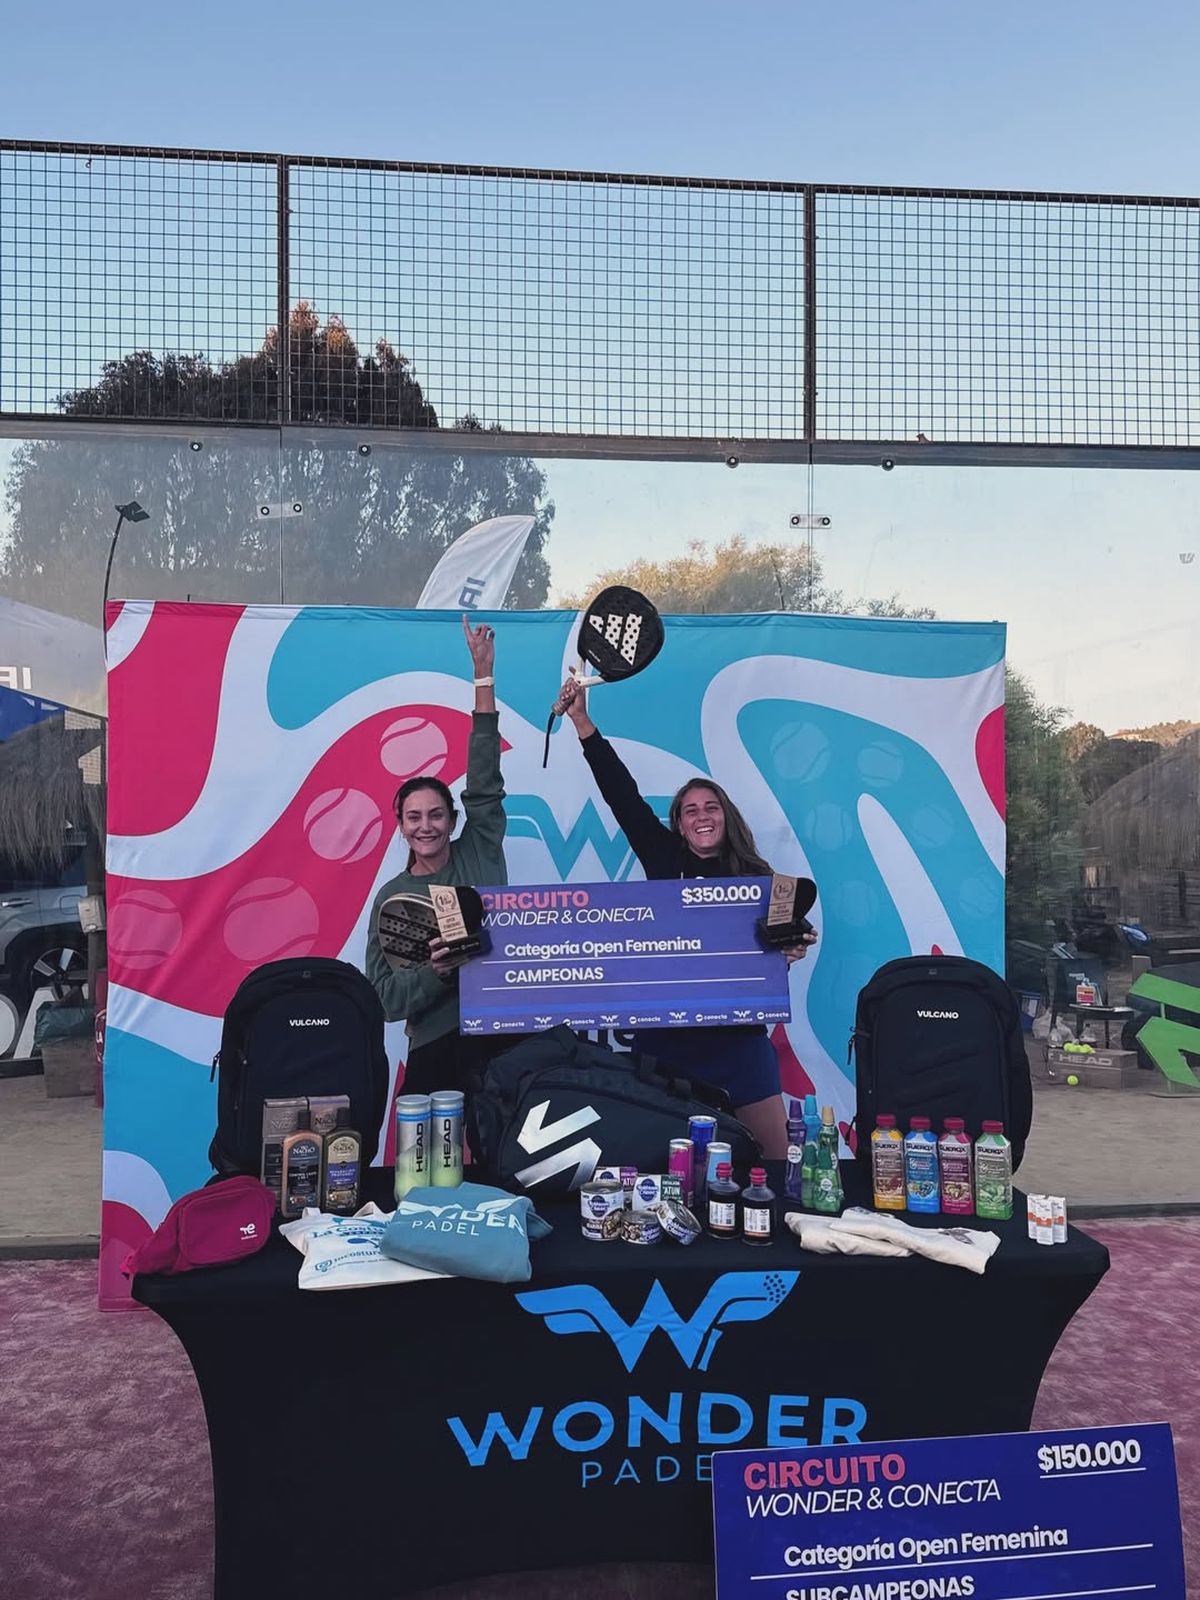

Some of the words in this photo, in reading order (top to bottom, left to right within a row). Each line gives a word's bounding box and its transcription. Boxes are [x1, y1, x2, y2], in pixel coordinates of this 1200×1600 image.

[480, 890, 590, 910] CIRCUITO
[681, 884, 762, 904] $350.000
[481, 910, 559, 927] WONDER
[561, 909, 573, 924] &
[575, 906, 655, 924] CONECTA
[504, 940, 580, 960] Categoría
[582, 941, 624, 958] Open
[626, 936, 702, 953] Femenina
[504, 967, 604, 983] CAMPEONAS
[289, 1018, 330, 1027] VULCANO
[916, 1010, 959, 1019] VULCANO
[1059, 1053, 1113, 1066] HEAD
[416, 1122, 424, 1173] HEAD
[443, 1118, 451, 1168] HEAD
[412, 1219, 480, 1236] PADEL
[446, 1391, 869, 1467] WONDER
[1037, 1438, 1142, 1473] $150.000
[581, 1454, 713, 1489] PADE
[743, 1453, 906, 1491] CIRCUITO
[746, 1488, 864, 1519] WONDER
[866, 1486, 884, 1511] &
[887, 1478, 1002, 1508] CONECTA
[783, 1536, 896, 1570] Categoría
[898, 1536, 958, 1564] Open
[961, 1524, 1068, 1554] Femenina
